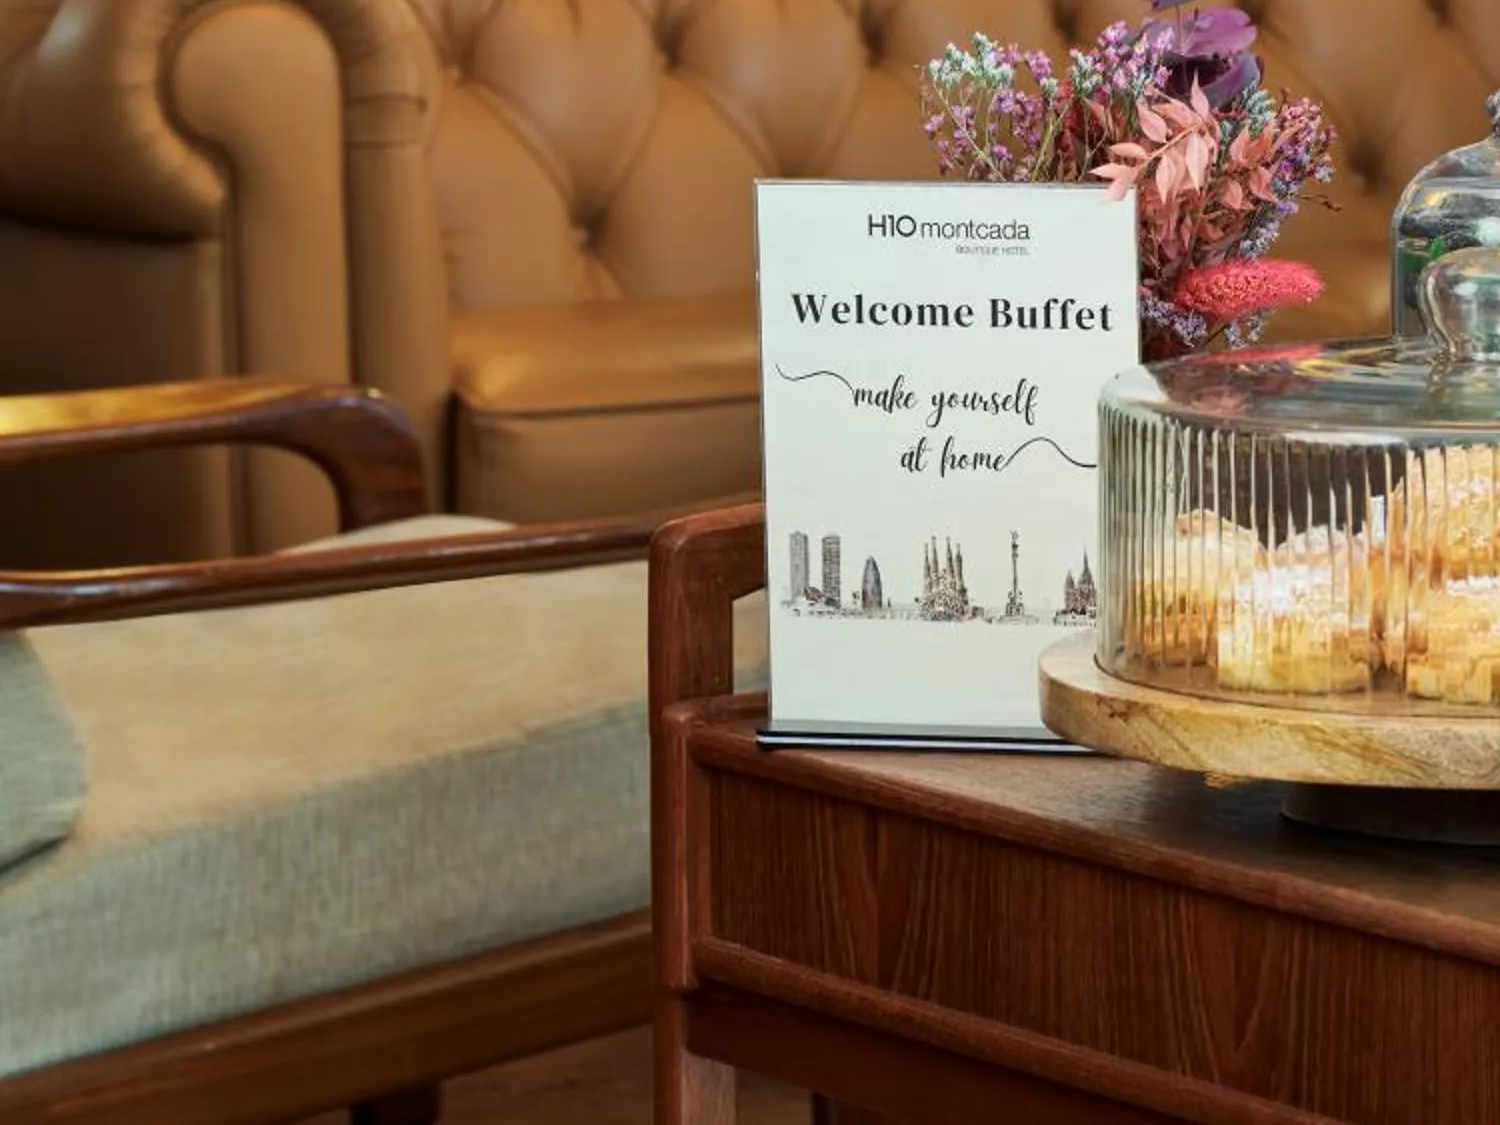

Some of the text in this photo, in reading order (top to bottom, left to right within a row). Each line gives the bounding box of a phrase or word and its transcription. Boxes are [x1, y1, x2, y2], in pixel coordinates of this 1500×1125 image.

[920, 219, 1031, 241] montcada
[791, 293, 1113, 332] Welcome Buffet
[852, 374, 1038, 429] make yourself
[899, 435, 1007, 479] at home
